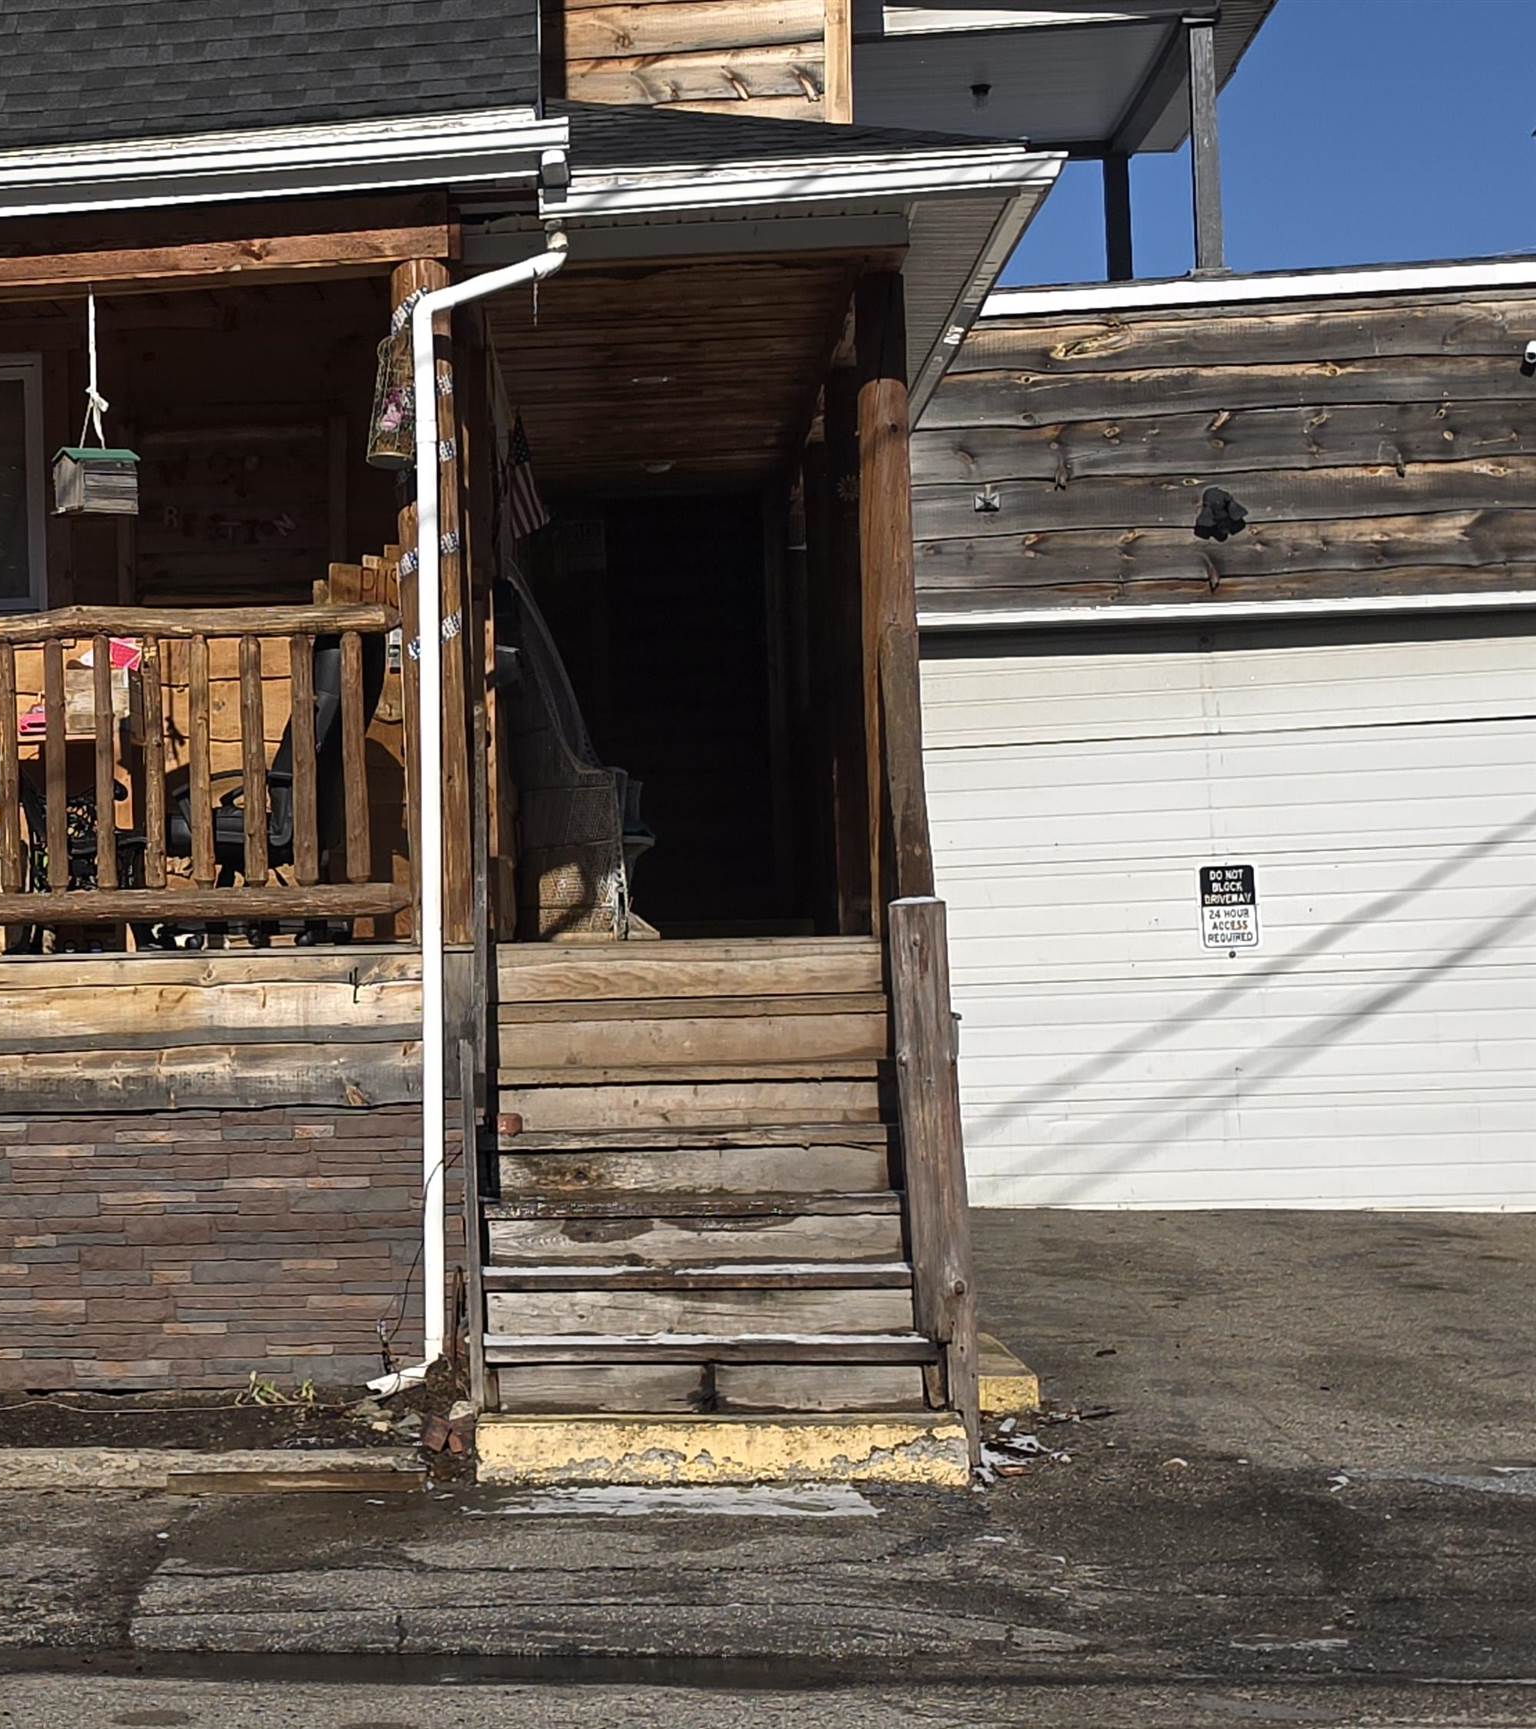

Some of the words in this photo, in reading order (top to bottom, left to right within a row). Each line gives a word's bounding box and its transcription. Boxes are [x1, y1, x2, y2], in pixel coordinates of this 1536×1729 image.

[1209, 870, 1223, 880] DO
[1225, 869, 1244, 880] NOT
[1212, 882, 1243, 892] BLOCK
[1204, 893, 1252, 904] DRIVEWAY
[1209, 909, 1221, 919] 24
[1224, 908, 1249, 919] HOUR
[1212, 920, 1248, 930] ACCESS
[1208, 933, 1253, 942] REQUIRED
